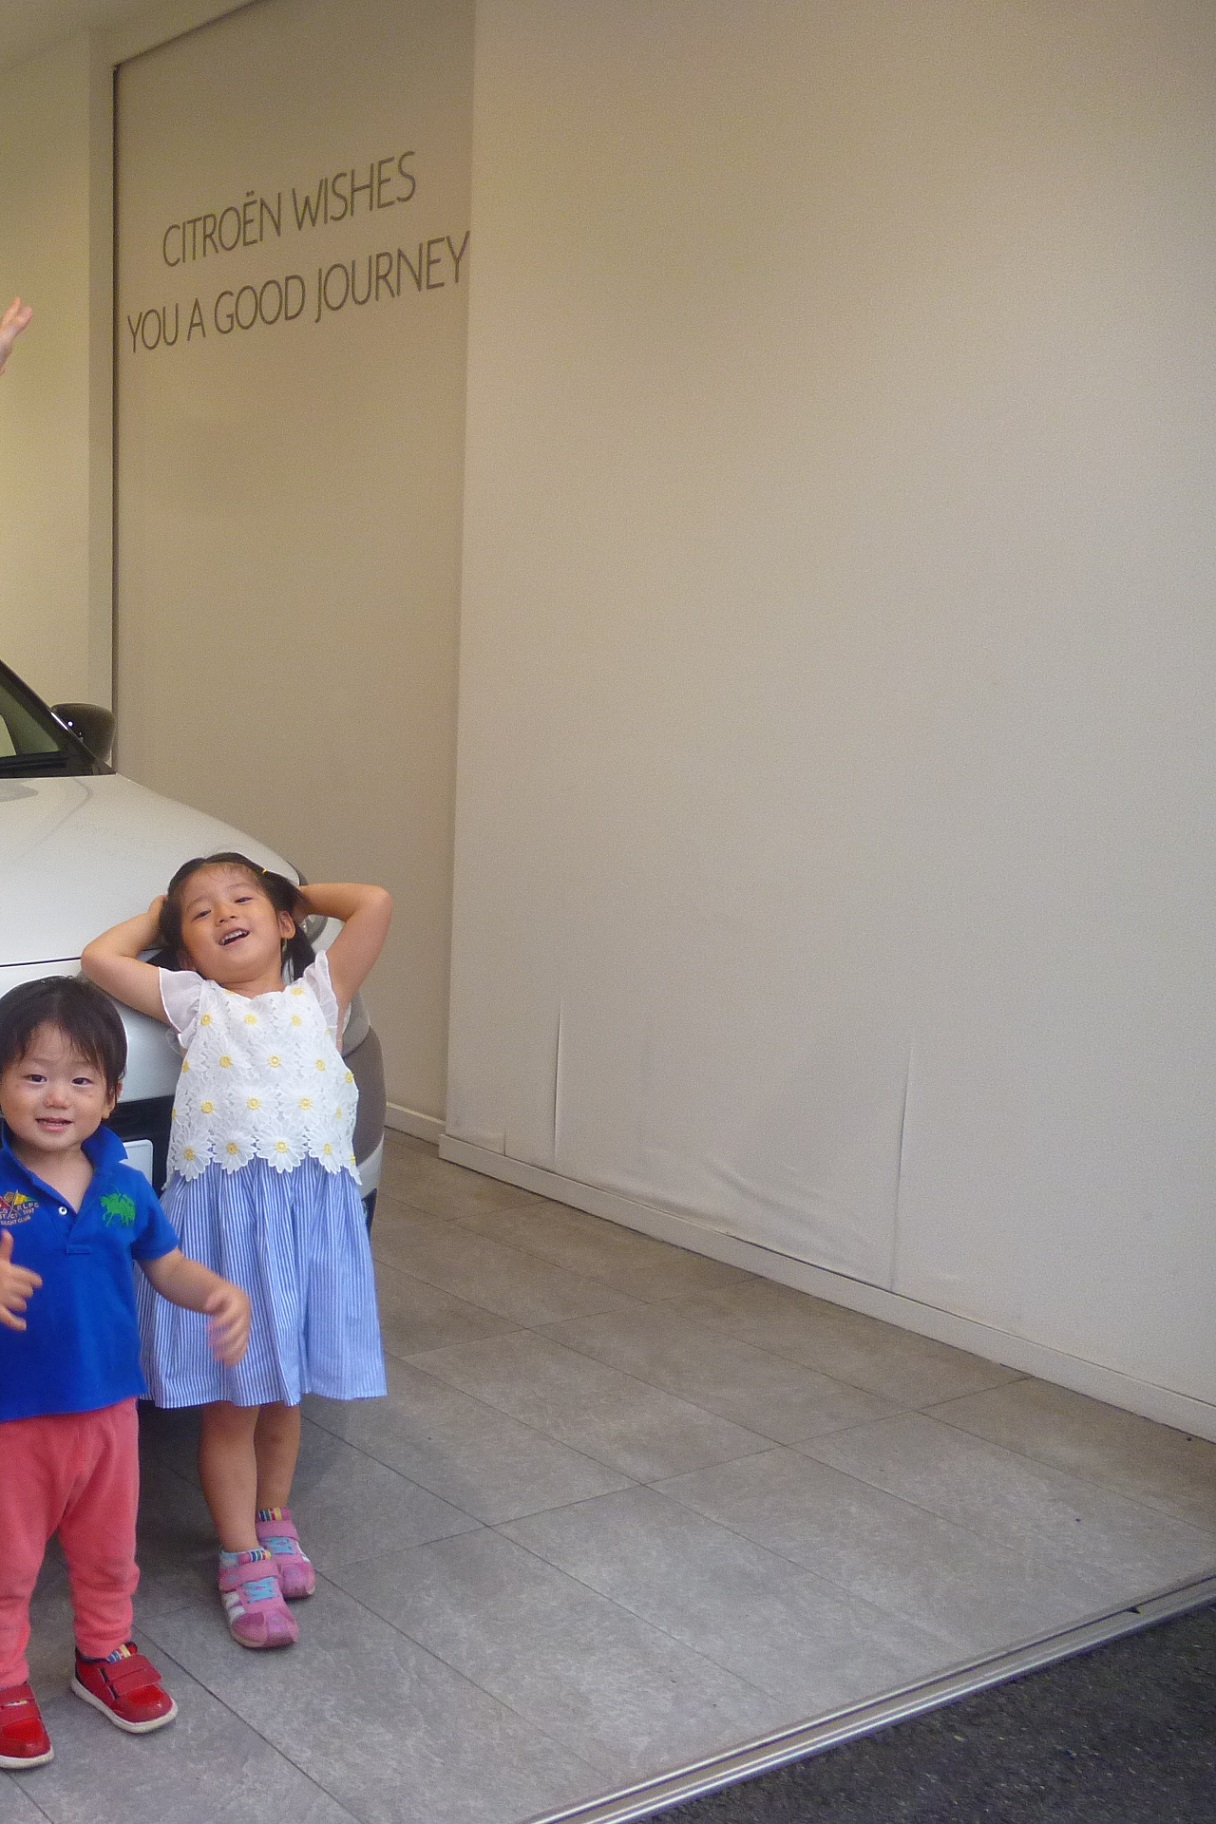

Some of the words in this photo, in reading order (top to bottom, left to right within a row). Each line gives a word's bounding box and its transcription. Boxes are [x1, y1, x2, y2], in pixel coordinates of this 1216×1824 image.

[162, 190, 282, 267] CITROËN
[292, 150, 417, 231] WISHES
[127, 302, 180, 353] YOU
[187, 297, 206, 341] A
[214, 274, 306, 334] GOOD
[314, 230, 471, 323] JOURNEY
